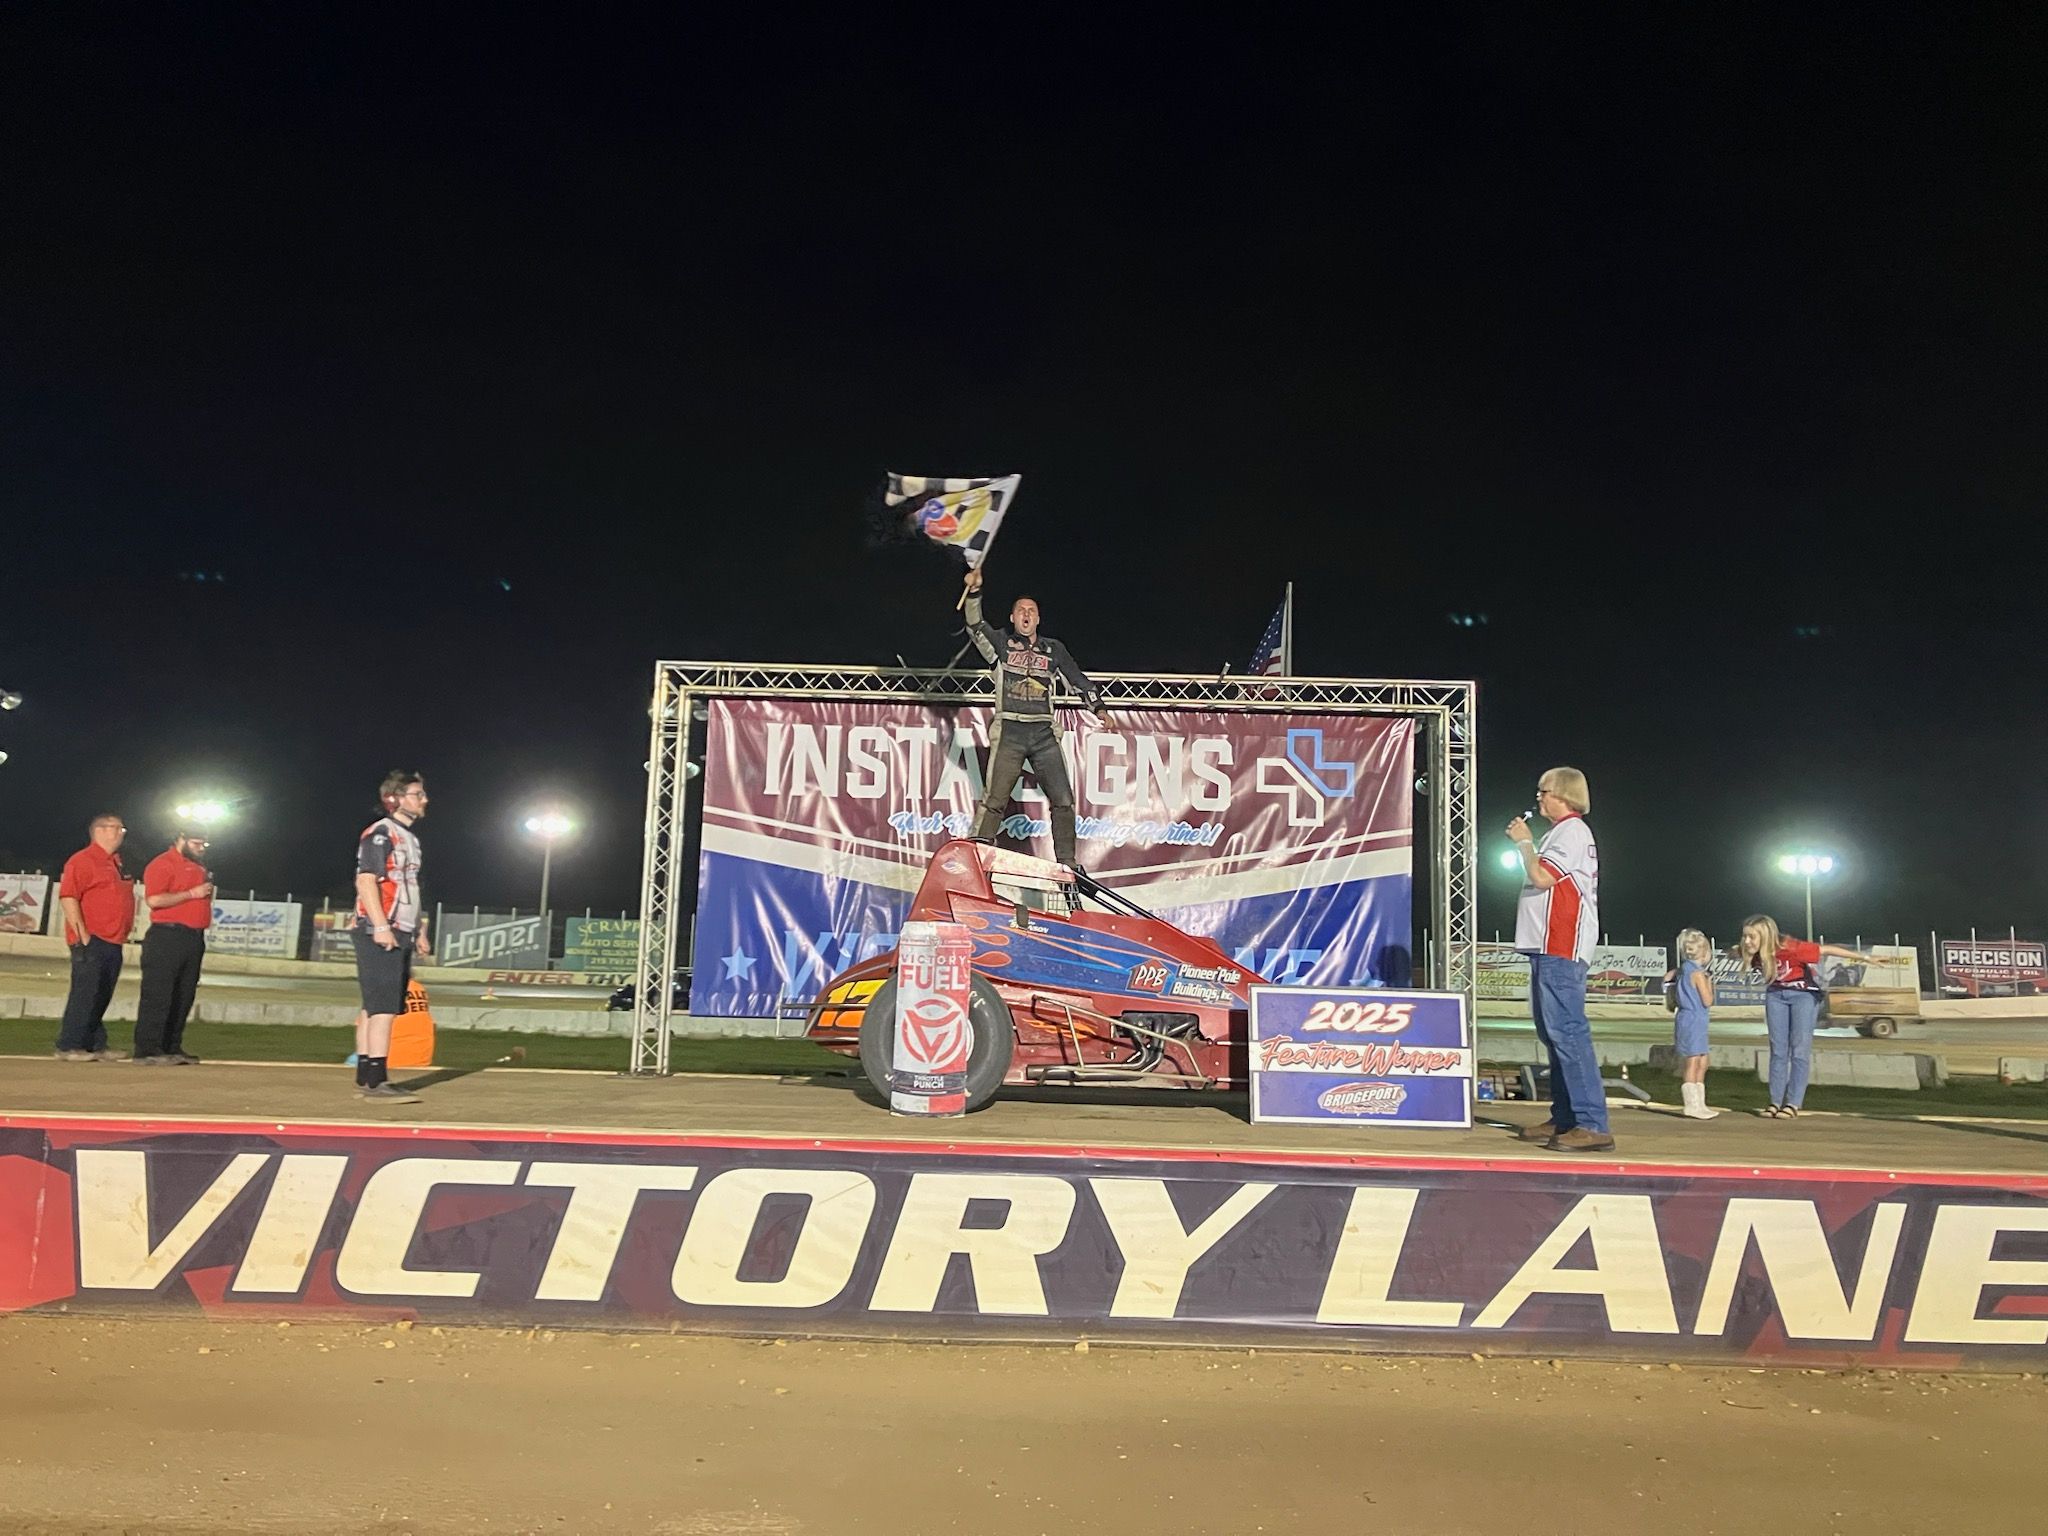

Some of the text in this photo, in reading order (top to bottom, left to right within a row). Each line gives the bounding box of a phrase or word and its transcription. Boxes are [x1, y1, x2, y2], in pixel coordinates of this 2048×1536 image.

[763, 722, 1232, 812] INSTAGNS
[1002, 815, 1051, 840] Run
[1136, 821, 1224, 848] Partner!
[577, 920, 641, 936] SCRAPP
[444, 917, 541, 966] Hyper
[581, 938, 640, 948] AUTO SERV
[900, 954, 966, 966] VICTORY
[1602, 954, 1624, 969] For
[1627, 955, 1665, 969] Vision
[1946, 949, 2042, 967] PRECISON
[488, 971, 631, 985] ENTER THY
[899, 964, 967, 991] FUEL
[1134, 964, 1168, 987] PPB
[1178, 963, 1218, 981] Pioneer
[1216, 967, 1241, 984] Pole
[1172, 981, 1219, 1001] Buildings,
[1301, 1001, 1416, 1033] 2025
[1260, 1034, 1461, 1077] Feature Winner
[913, 1081, 945, 1089] PUNCH
[1323, 1086, 1401, 1107] BRIDGEPORT
[75, 1148, 2048, 1345] VICTORY LANE
